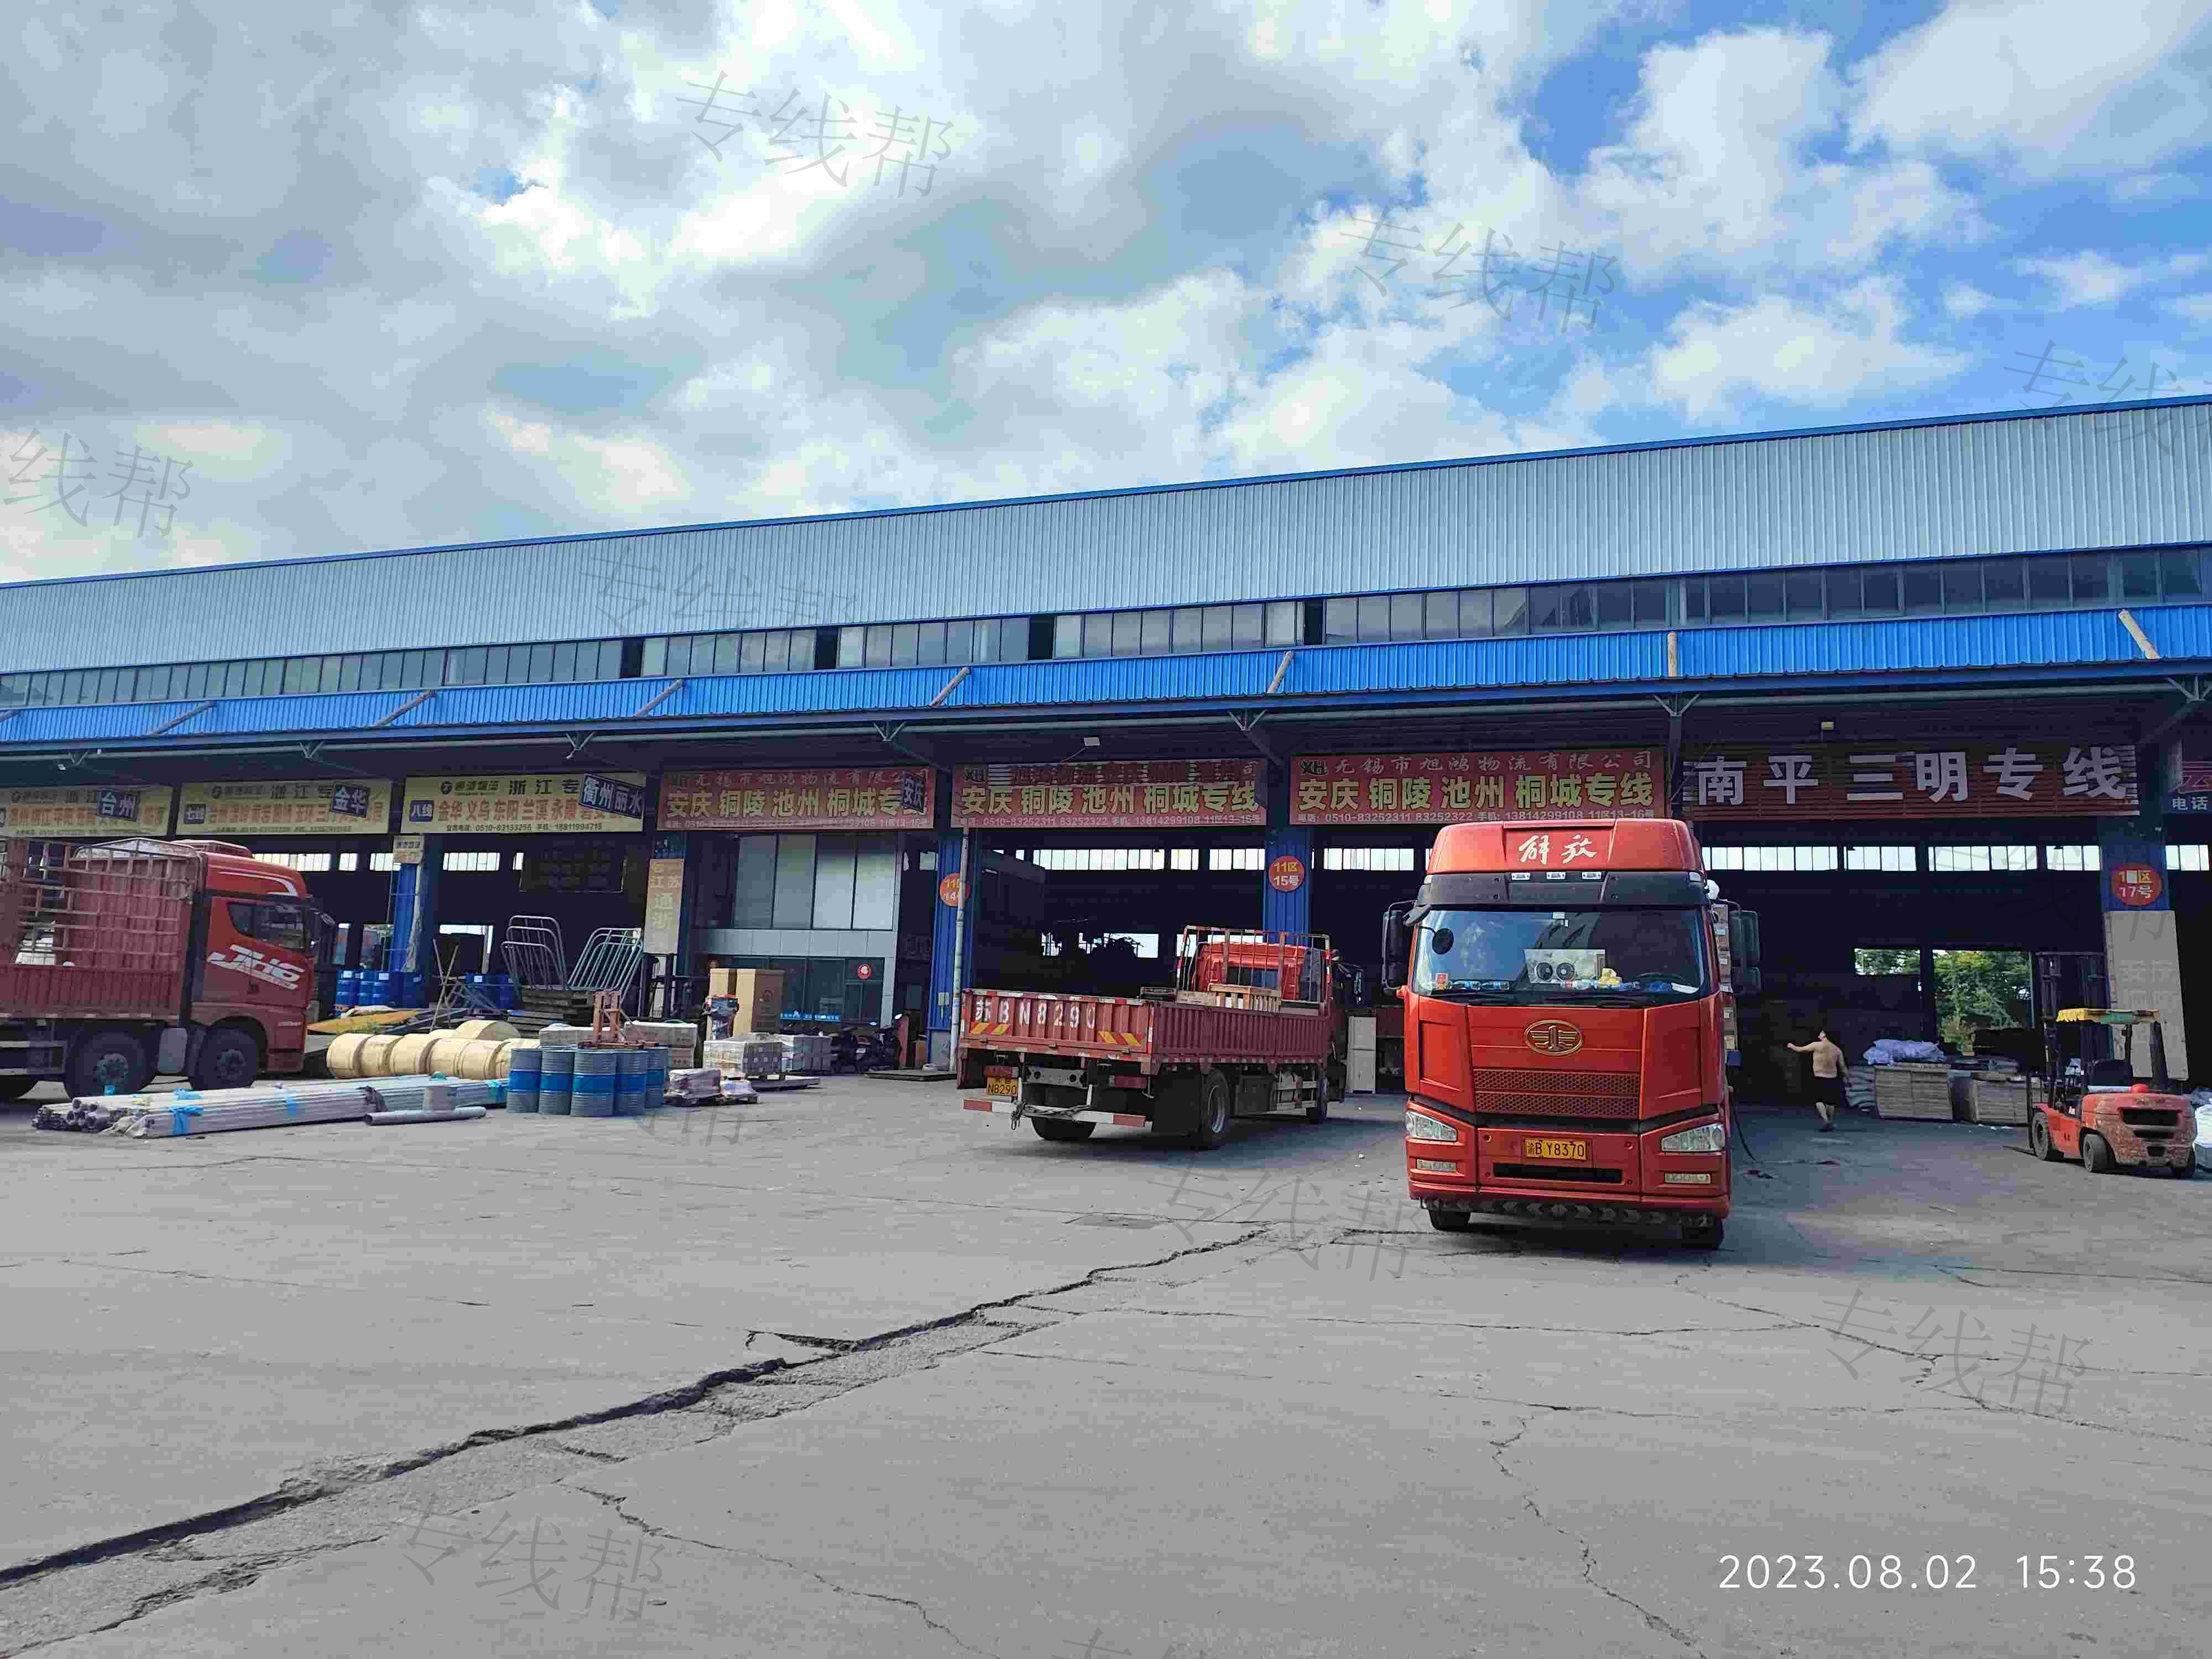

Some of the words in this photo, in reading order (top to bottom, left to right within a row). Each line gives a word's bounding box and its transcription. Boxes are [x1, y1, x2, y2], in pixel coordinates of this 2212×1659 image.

[1335, 751, 1652, 774] 无锡市旭鸿物流有限公司
[1698, 747, 2125, 805] 南平三明专线
[101, 789, 135, 820] 台州
[614, 787, 642, 814] 丽水
[667, 789, 713, 818] 安庆
[718, 788, 766, 818] 铜陵
[771, 788, 819, 817] 池州
[959, 787, 1013, 815] 安庆
[1020, 786, 1073, 814] 铜陵
[1081, 786, 1134, 814] 池州
[1144, 784, 1259, 813] 桐城专线
[1298, 777, 1359, 811] 安庆
[1368, 776, 1431, 810] 铜陵
[1441, 775, 1505, 809] 池州
[1515, 773, 1654, 808] 桐城专线
[2172, 796, 2208, 810] 电话
[1326, 812, 1411, 822] 0510-83252311
[1415, 812, 1473, 822] 83252322
[1505, 810, 1584, 820] 13814299108
[1517, 834, 1598, 865] 解放
[1274, 861, 1298, 872] 11区
[2119, 869, 2153, 884] 1区
[2119, 885, 2153, 899] 17号
[988, 1083, 1017, 1095] N8290
